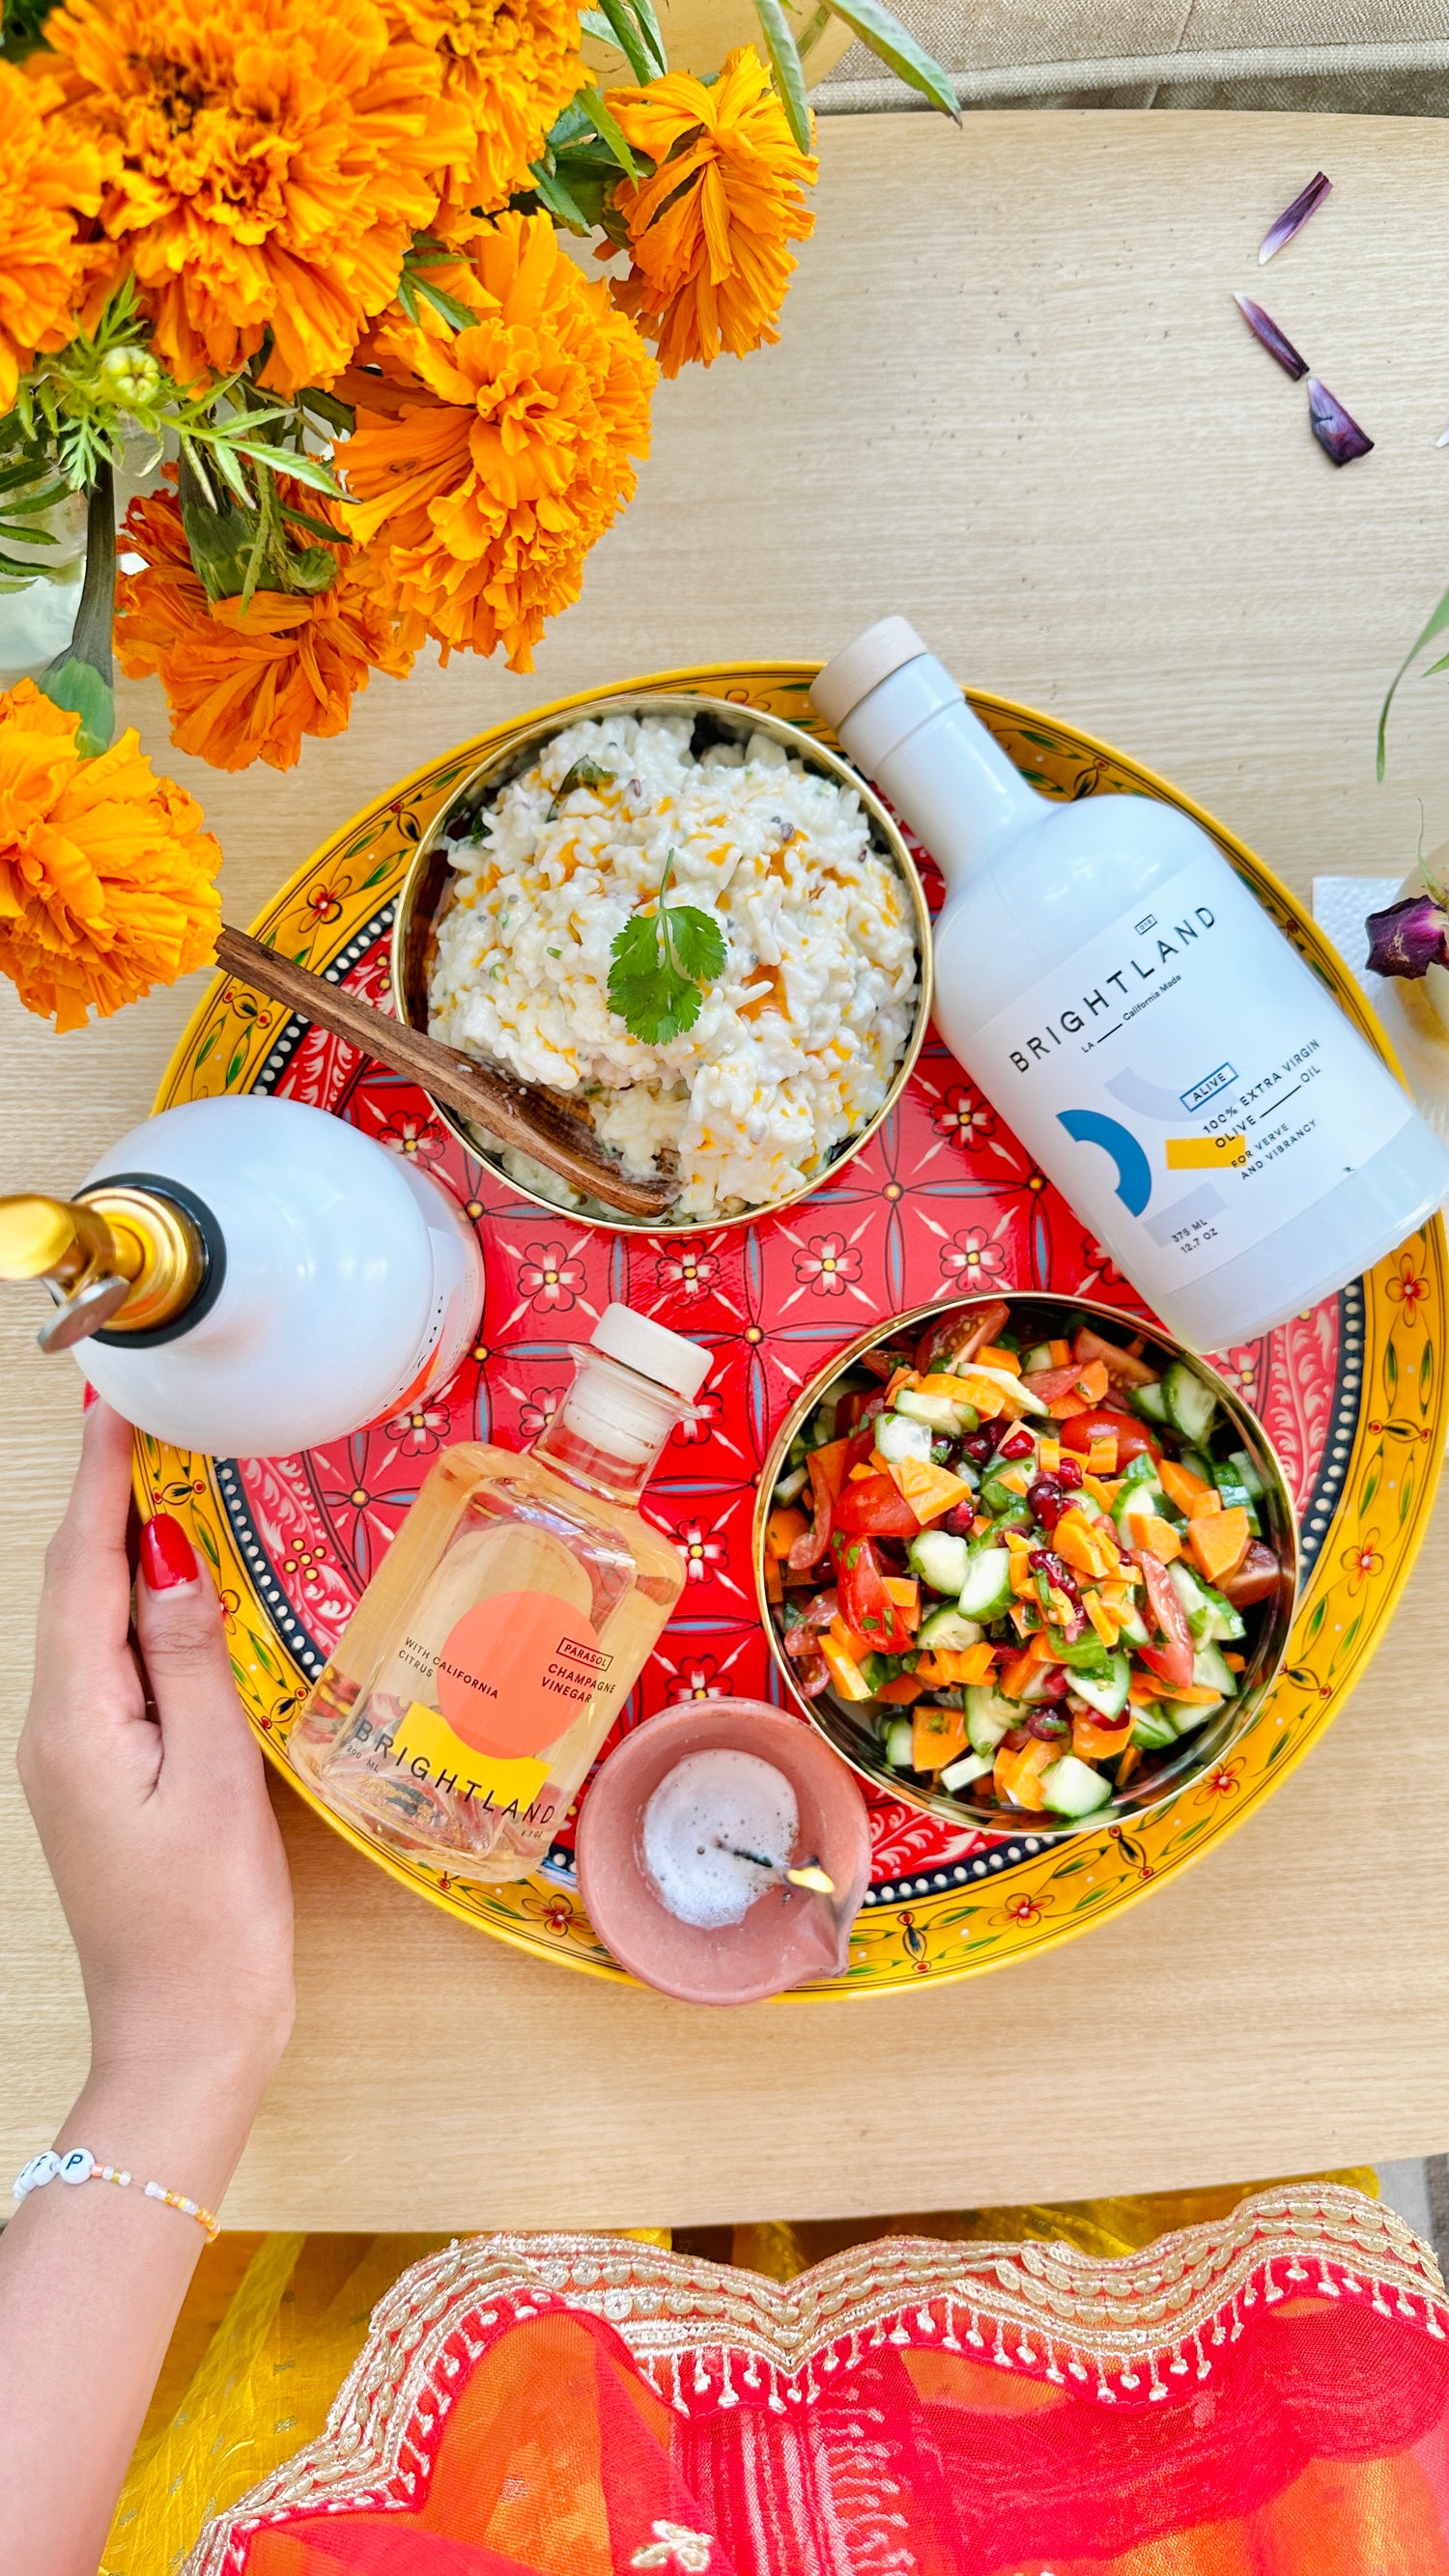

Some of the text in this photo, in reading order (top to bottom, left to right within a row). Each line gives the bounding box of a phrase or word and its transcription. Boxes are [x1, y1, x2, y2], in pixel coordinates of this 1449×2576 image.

[1009, 907, 1215, 1073] BRIGHTLAND
[1081, 975, 1181, 1054] LA California Made
[1192, 1072, 1227, 1102] ALIVE
[1203, 1038, 1321, 1134] 100% EXTRA VIRGIN
[1214, 1065, 1321, 1148] OLIVE OIL
[1231, 1122, 1290, 1169] FOR VERVE
[1240, 1118, 1317, 1180] AND VIBRANCY
[1171, 1219, 1208, 1243] 375 ML
[1180, 1228, 1218, 1254] 12.7 OZ
[398, 1650, 434, 1678] CITRUS
[405, 1637, 498, 1699] WITH CALIFORNIA
[563, 1644, 607, 1667] PARASOL
[541, 1676, 593, 1703] VINEGAR
[548, 1663, 616, 1693] CHAMPAGNE
[347, 1744, 380, 1773] 200 ML
[355, 1718, 555, 1824] BRIGHTLAND
